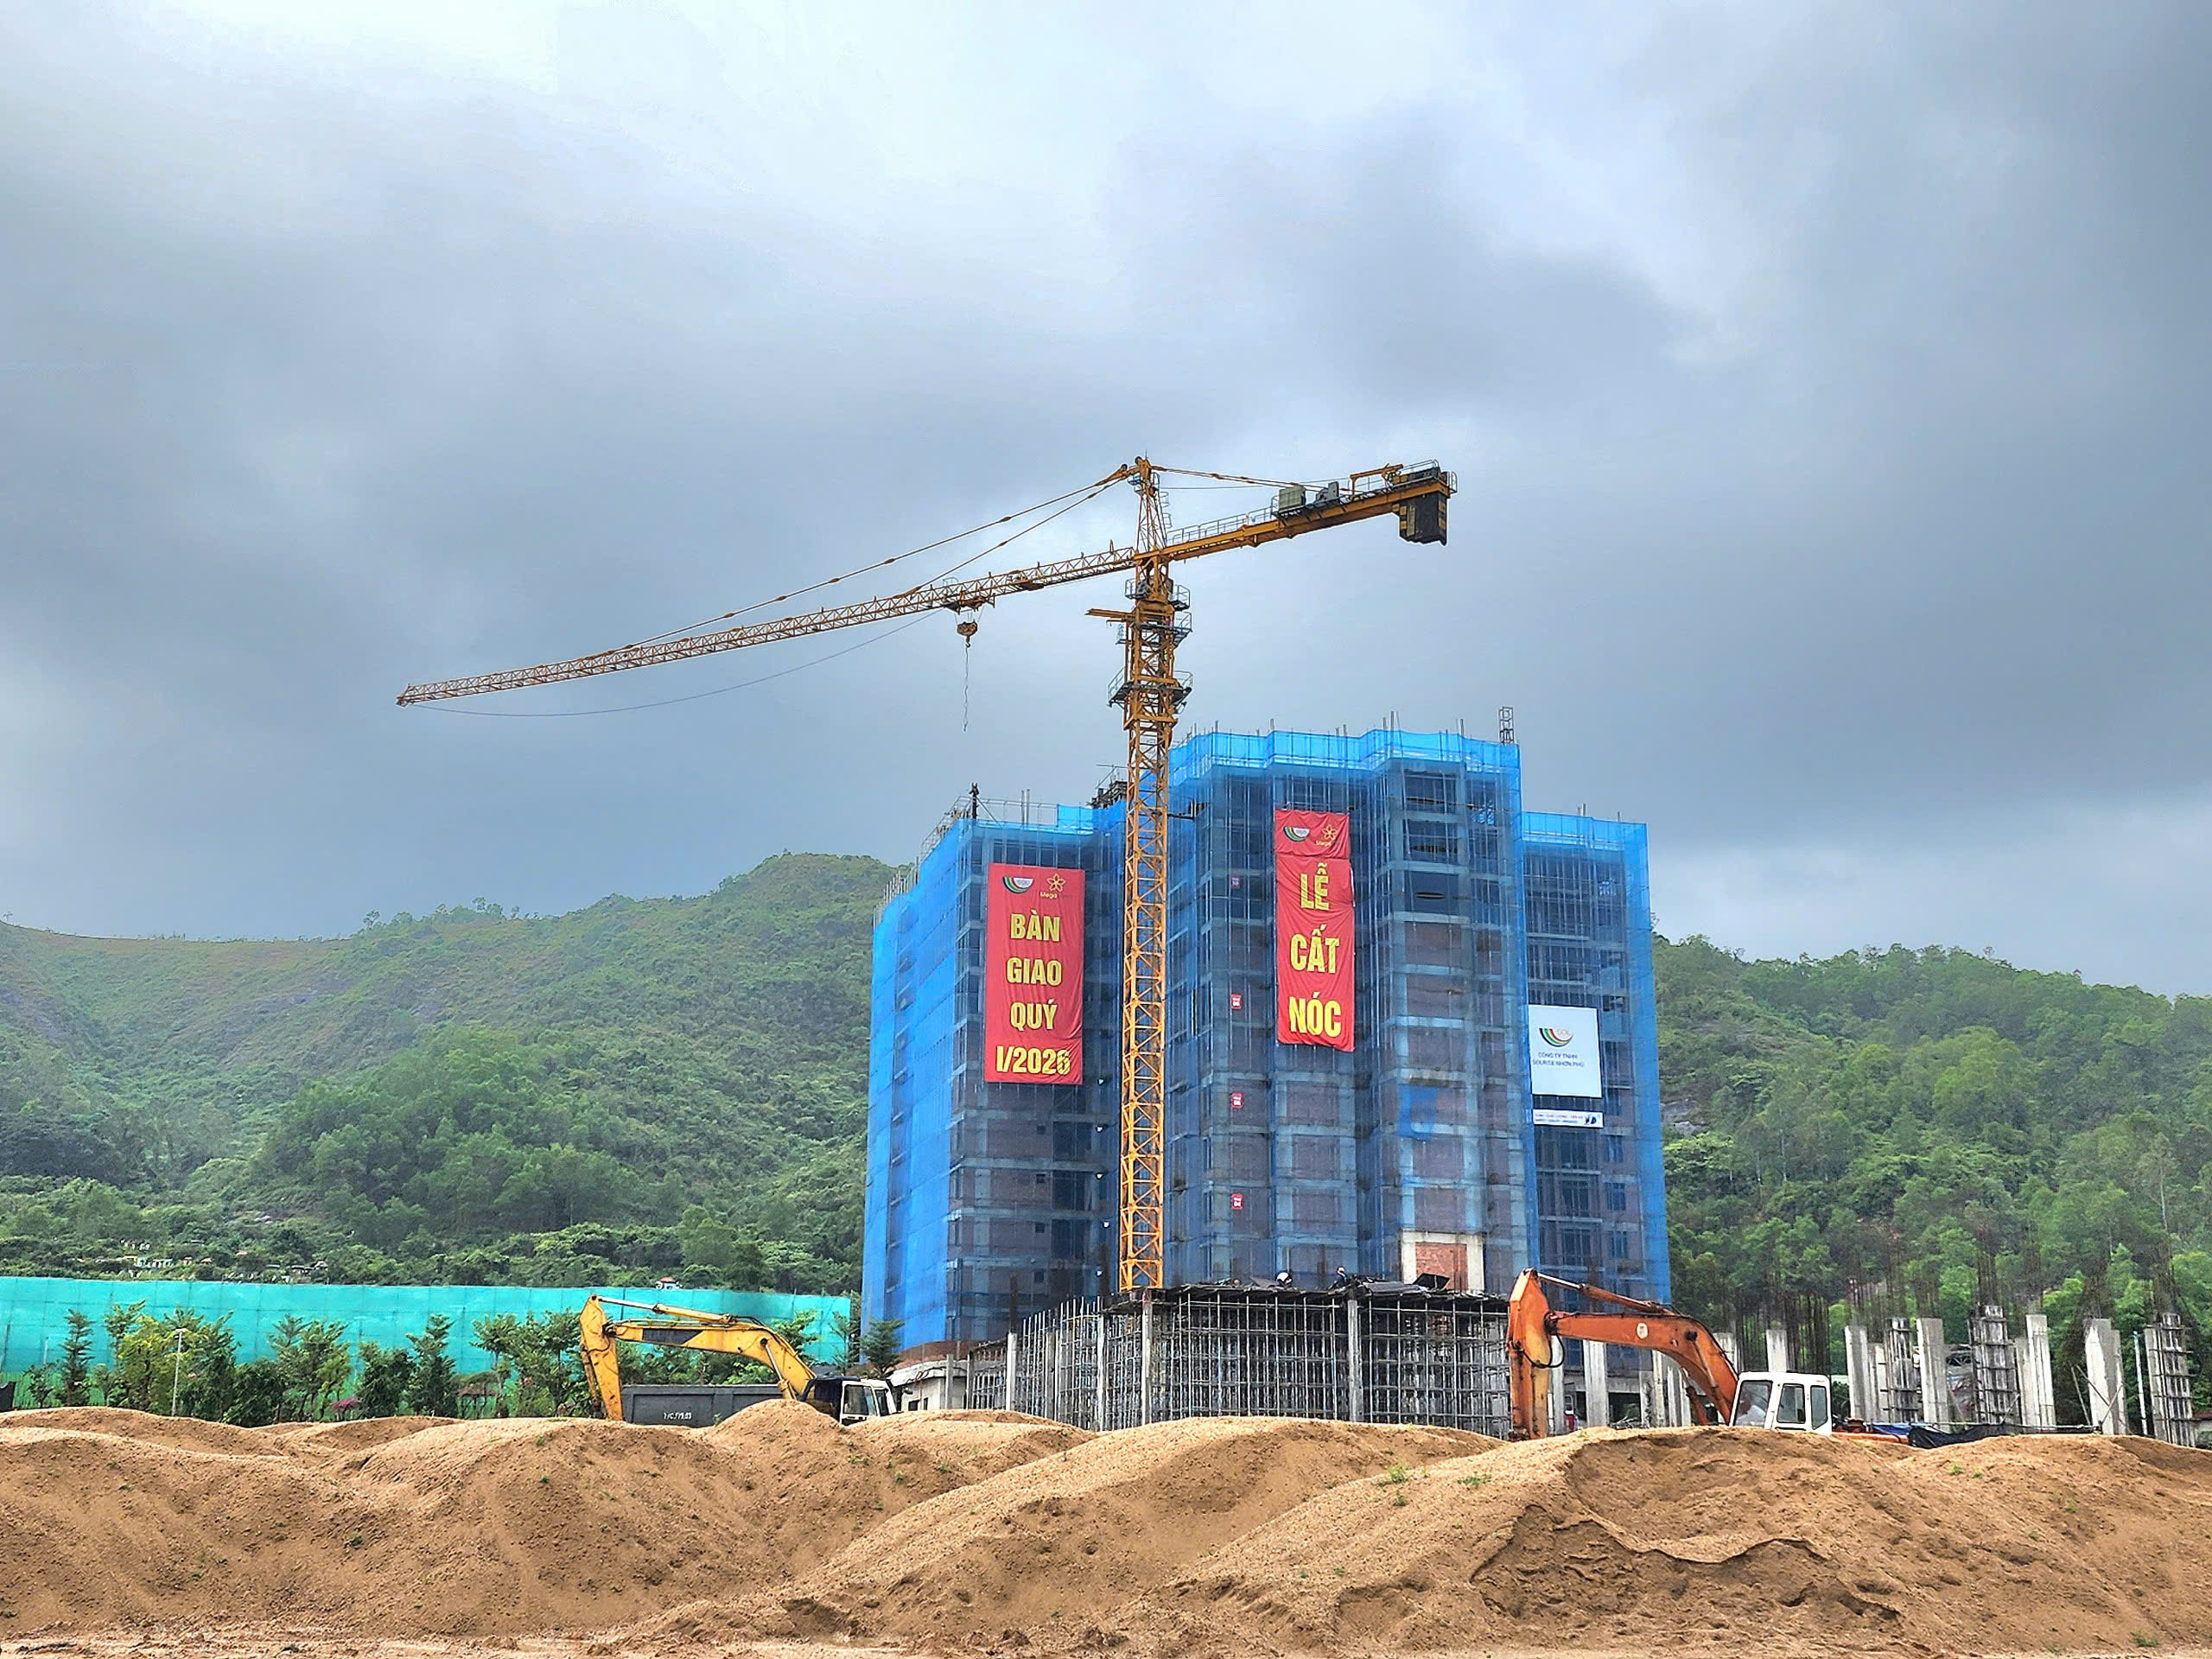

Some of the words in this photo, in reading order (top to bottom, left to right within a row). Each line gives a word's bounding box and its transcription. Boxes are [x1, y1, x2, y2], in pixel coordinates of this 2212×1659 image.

[1300, 862, 1330, 912] LỄ
[1010, 910, 1061, 942] BÀN
[1290, 924, 1340, 975] CẤT
[1006, 957, 1064, 987] GIAO
[1010, 999, 1058, 1032] QUÝ
[1288, 991, 1343, 1039] NÓC
[995, 1046, 1071, 1075] I/2026
